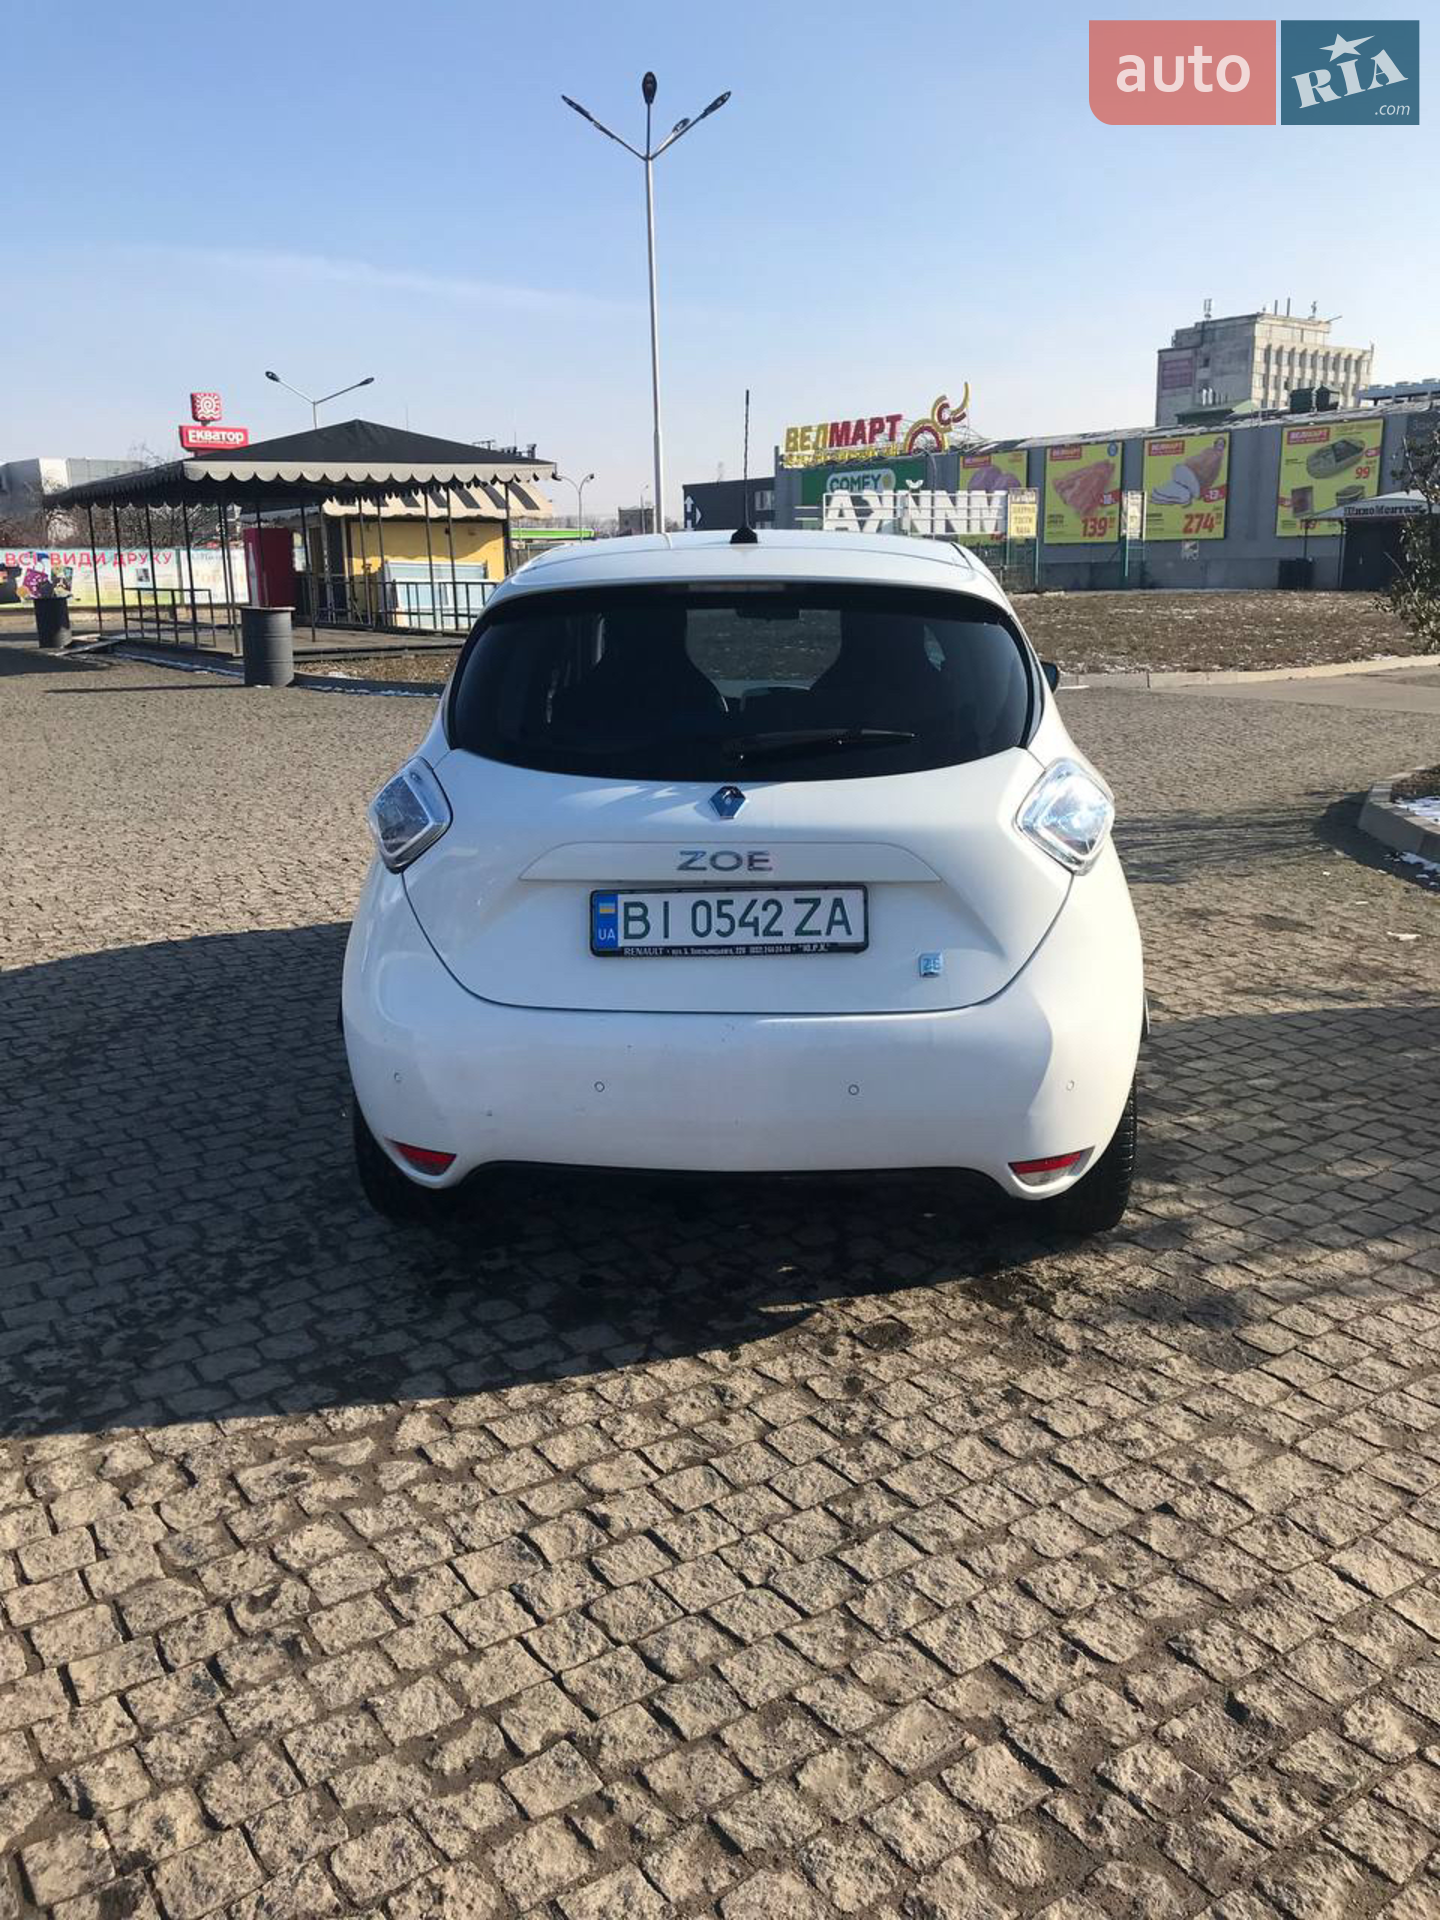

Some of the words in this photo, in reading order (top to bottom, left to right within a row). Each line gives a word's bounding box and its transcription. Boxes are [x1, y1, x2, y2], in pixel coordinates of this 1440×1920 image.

[785, 414, 903, 452] ВЕЛМАРТ
[829, 473, 882, 492] COMFY
[1081, 516, 1107, 537] 139
[1182, 513, 1215, 533] 274
[50, 552, 106, 568] ВИДИ
[113, 552, 172, 568] ДРУКУ
[677, 851, 773, 872] ZOE
[623, 901, 670, 940] BI
[691, 898, 783, 938] 0542
[794, 897, 852, 937] ZA
[598, 928, 616, 941] UA
[624, 947, 663, 957] RENAULT
